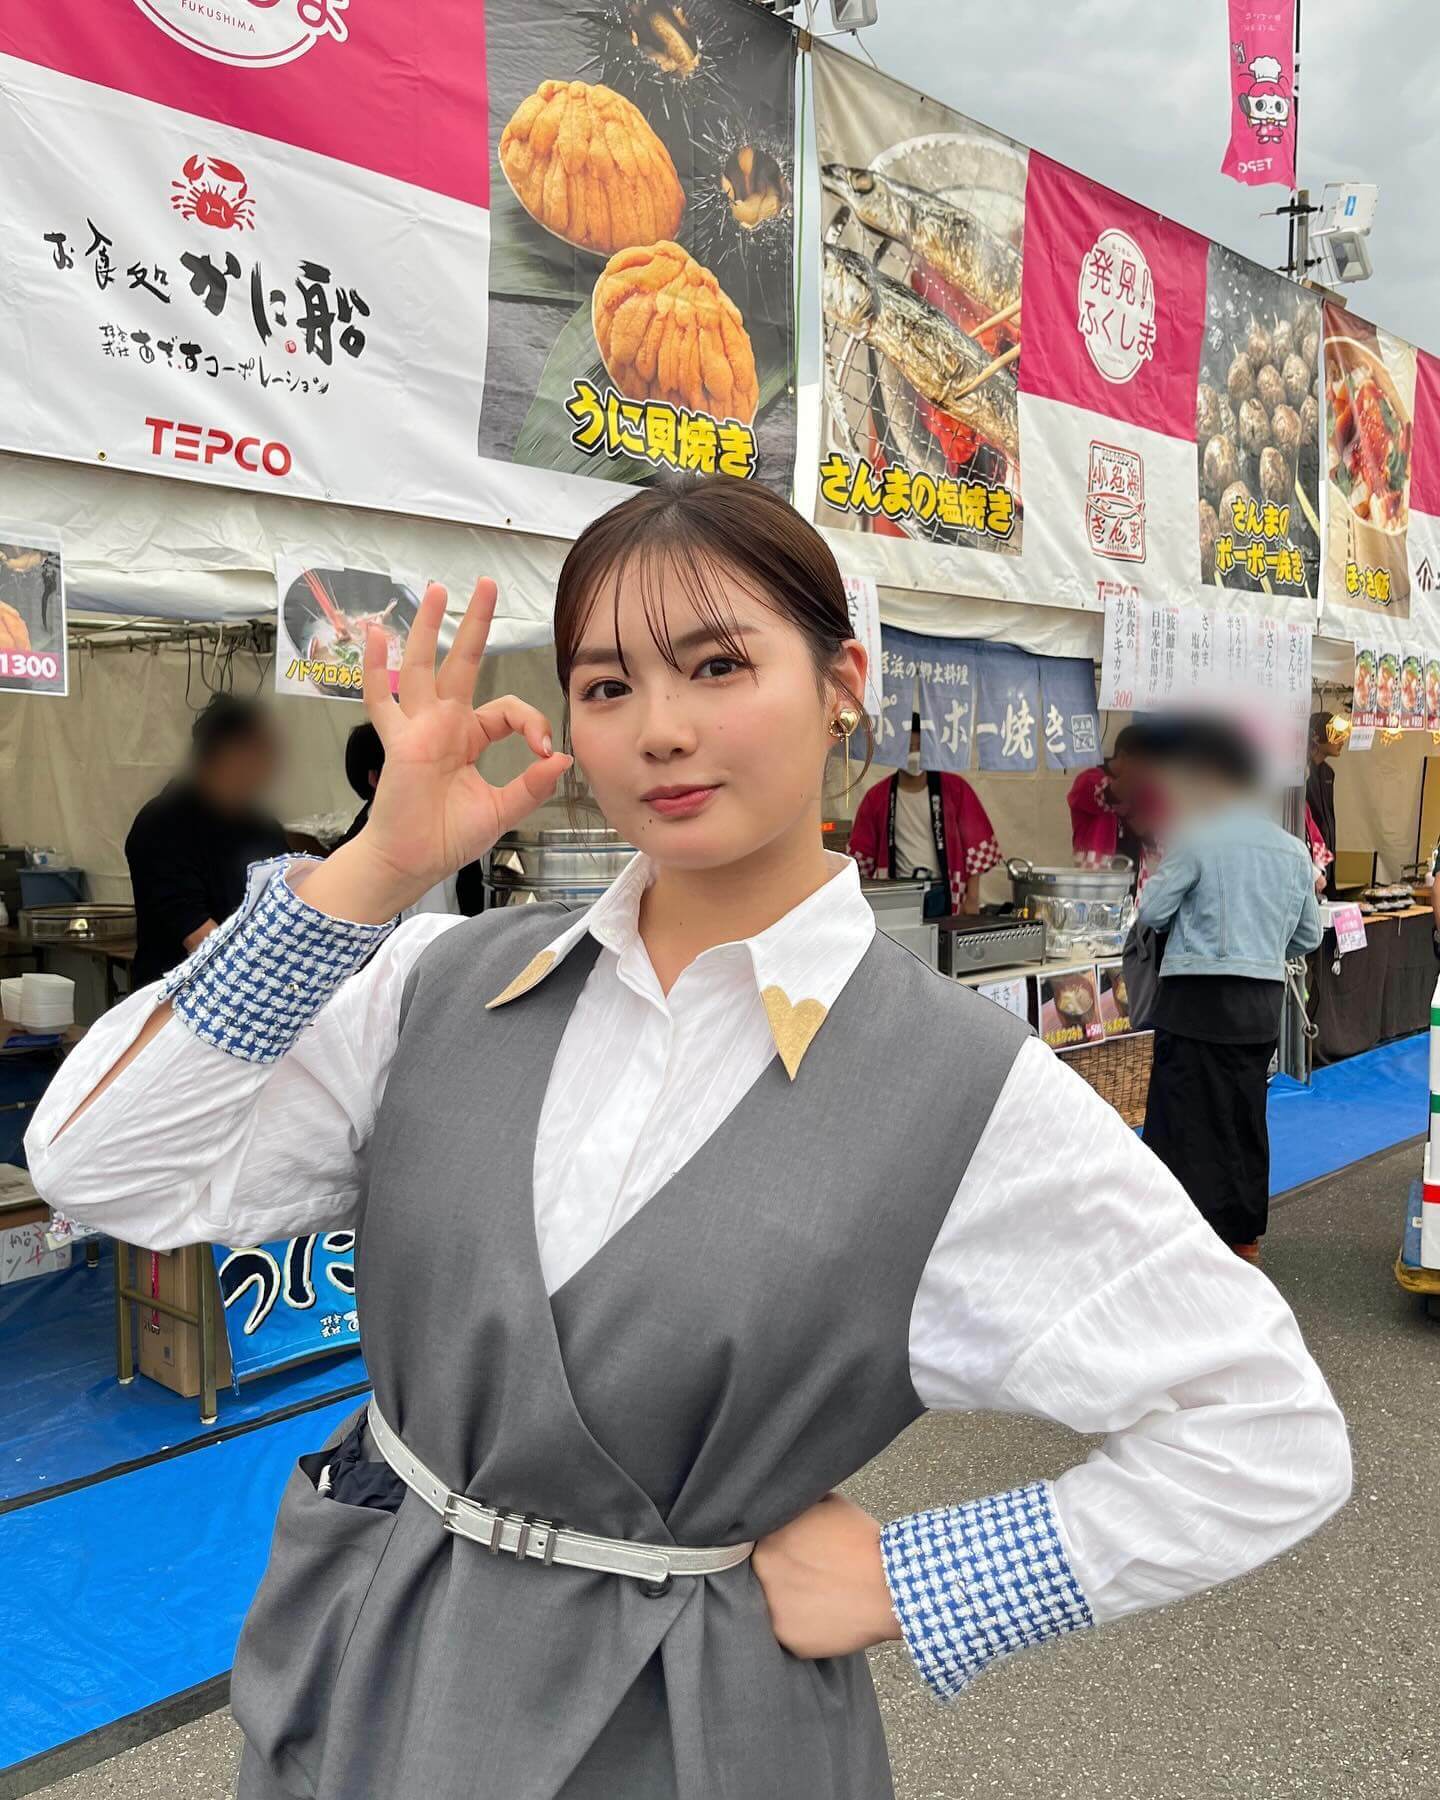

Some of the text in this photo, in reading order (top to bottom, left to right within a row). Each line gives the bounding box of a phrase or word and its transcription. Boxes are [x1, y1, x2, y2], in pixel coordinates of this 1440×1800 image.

[181, 0, 257, 34] FUKUSHIMA
[179, 251, 371, 366] かに船
[1083, 300, 1155, 357] ふくしま
[145, 416, 293, 477] TEPCO
[567, 381, 757, 478] うに貝焼き
[820, 453, 1015, 539] さんまの塩焼き
[1231, 496, 1290, 541] さんまの
[1090, 512, 1142, 549] さんま
